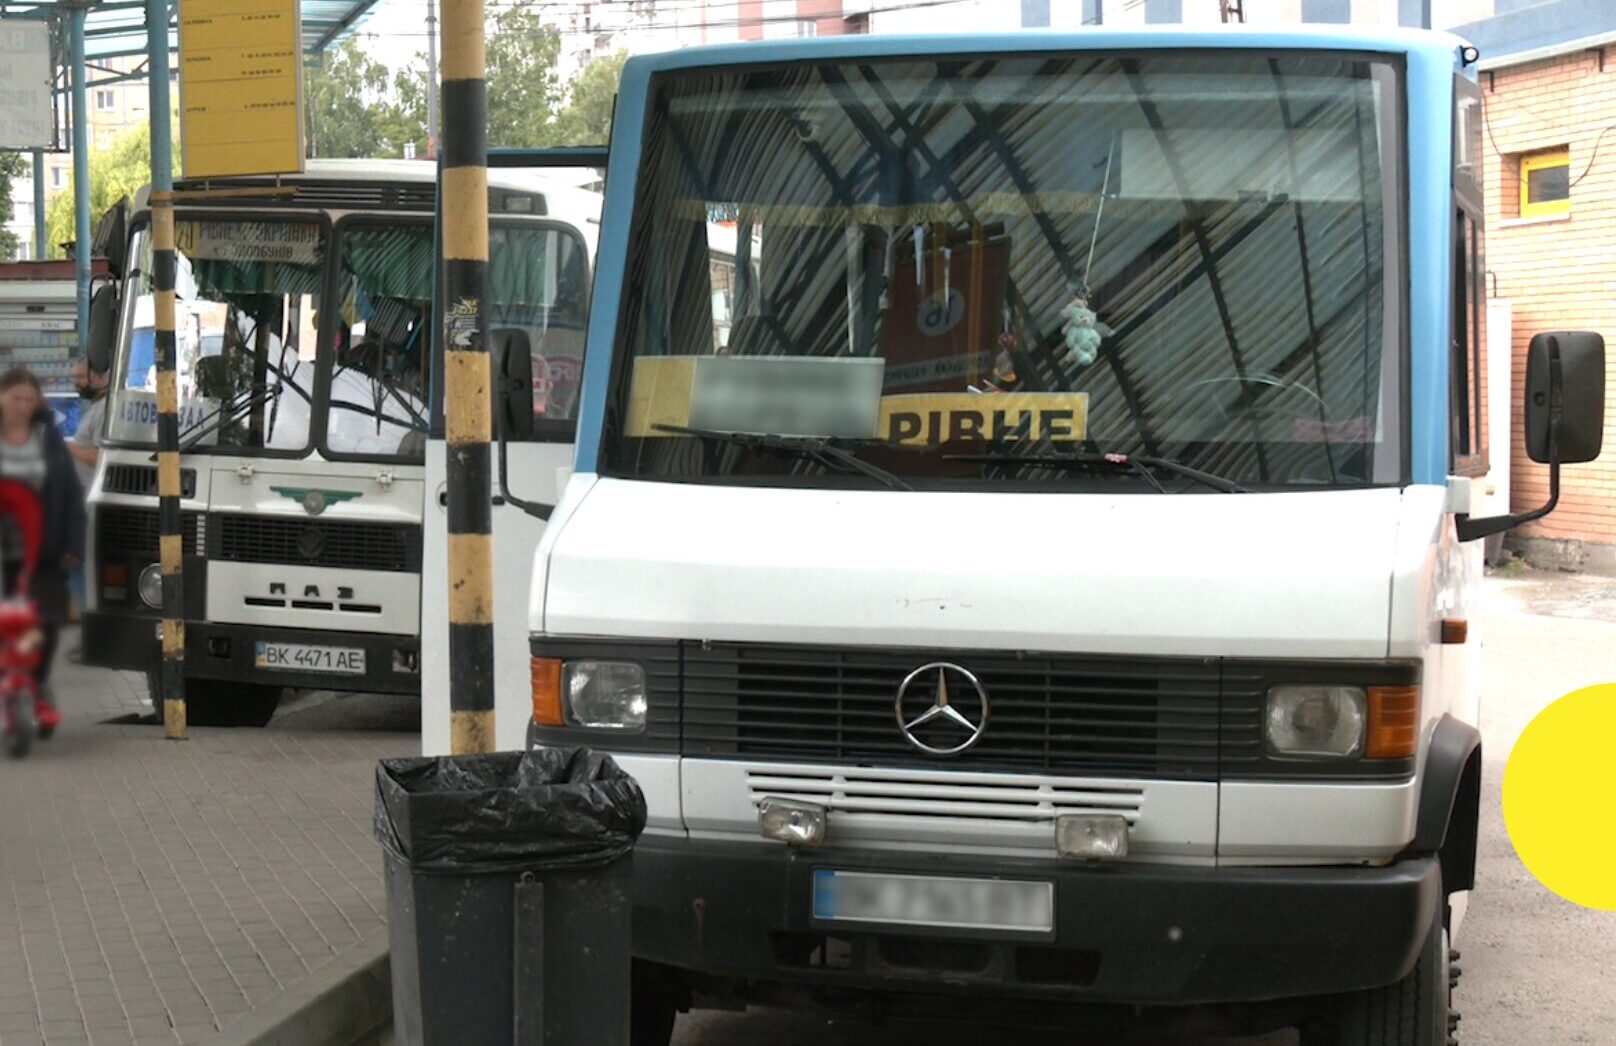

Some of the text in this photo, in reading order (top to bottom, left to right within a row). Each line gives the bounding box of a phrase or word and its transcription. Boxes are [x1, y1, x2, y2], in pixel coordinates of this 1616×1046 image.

[120, 400, 204, 429] АВТОВЗАЛ
[889, 409, 1074, 446] РІВНЕ
[269, 582, 354, 599] ПАЗ
[266, 646, 361, 670] BK 4471 AE
